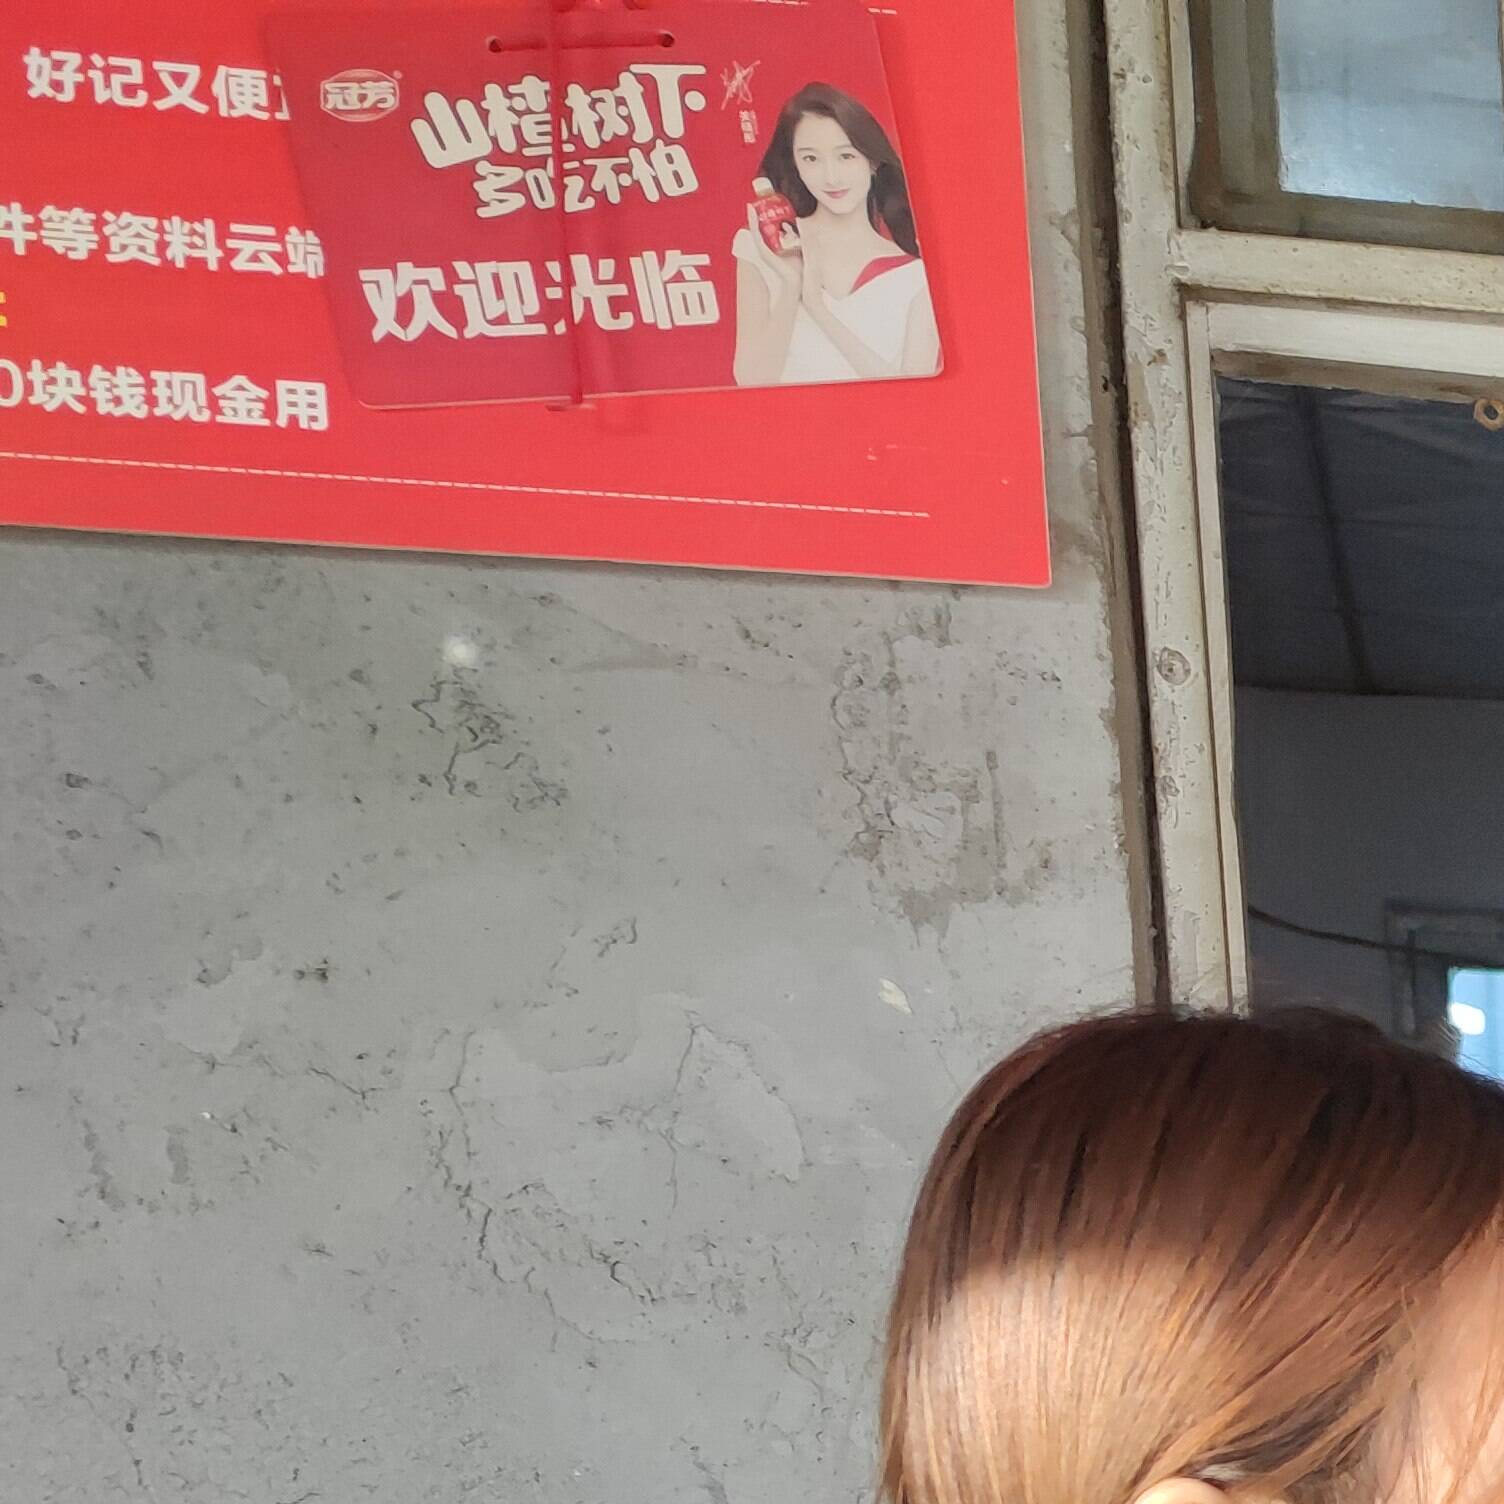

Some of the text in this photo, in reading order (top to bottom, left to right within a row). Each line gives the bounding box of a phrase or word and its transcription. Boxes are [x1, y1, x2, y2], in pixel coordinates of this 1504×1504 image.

[325, 80, 396, 110] 冠芳
[410, 64, 707, 168] 山楂树下
[473, 138, 700, 218] 多吃不怕
[358, 250, 720, 343] 欢迎光临
